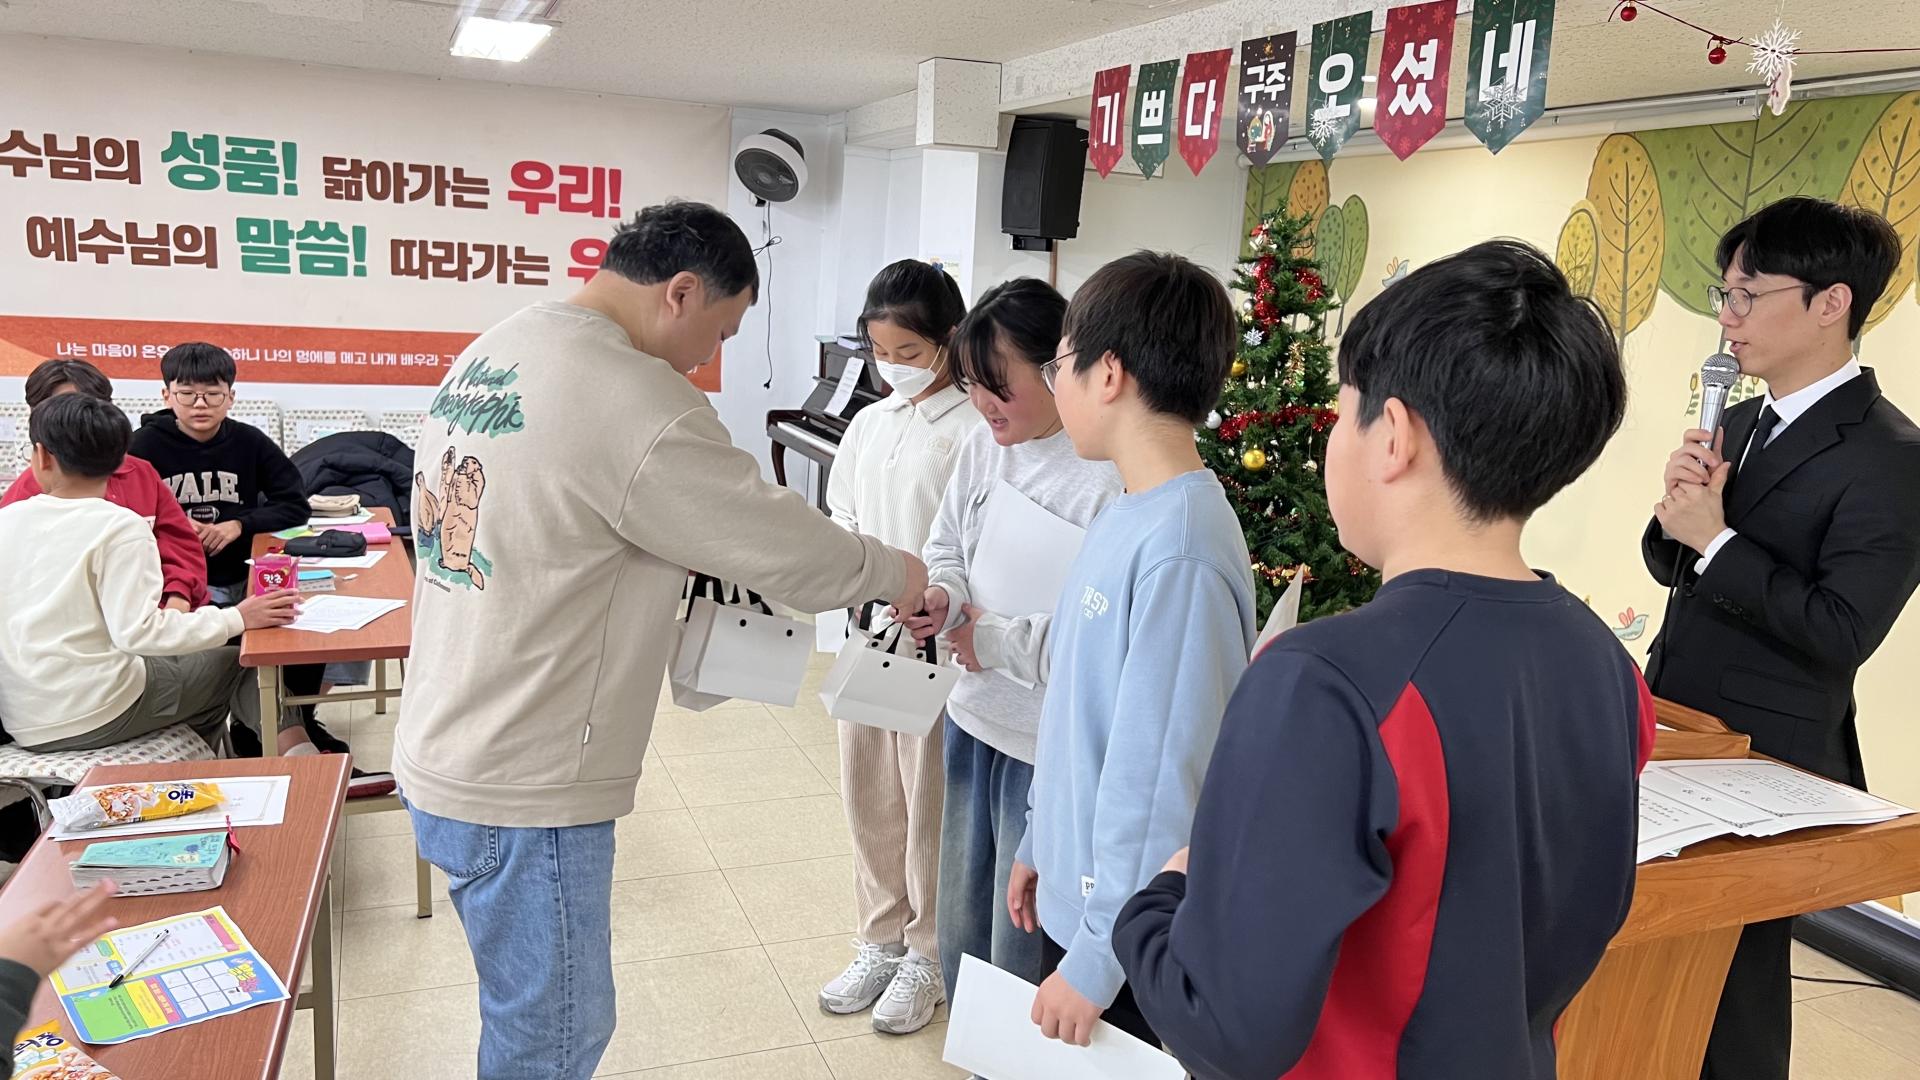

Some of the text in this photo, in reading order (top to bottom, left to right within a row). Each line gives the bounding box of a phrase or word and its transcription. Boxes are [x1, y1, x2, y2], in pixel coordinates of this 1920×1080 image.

[1244, 61, 1287, 104] 구주
[0, 130, 622, 218] 수님의 성품! 닮아가는 우리!
[26, 216, 217, 269] 예수님의
[236, 218, 367, 277] 말씀!
[390, 239, 550, 286] 따라가는
[56, 342, 88, 357] 나는
[92, 343, 138, 358] 마음이
[264, 348, 292, 363] 나의
[296, 350, 337, 364] 멍에를
[340, 352, 368, 365] 메고
[370, 353, 397, 365] 내게
[400, 354, 440, 367] 배우라
